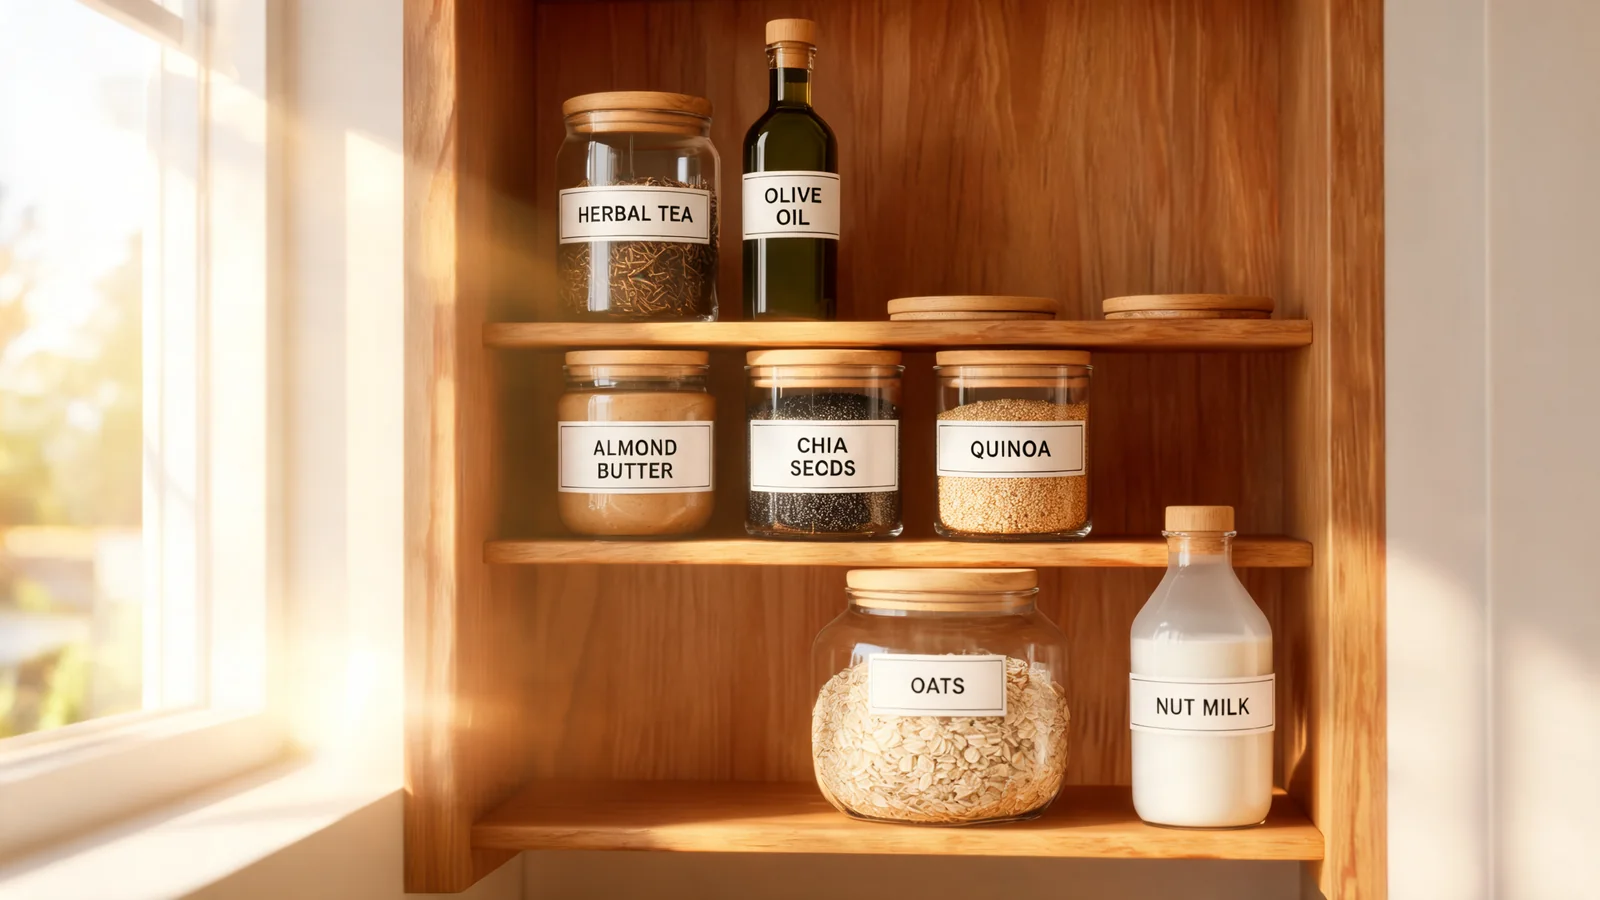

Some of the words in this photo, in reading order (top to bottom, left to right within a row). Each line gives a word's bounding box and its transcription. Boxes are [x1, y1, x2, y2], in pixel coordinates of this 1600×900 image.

[764, 186, 823, 204] OLIVE
[578, 205, 652, 224] HERBAL
[657, 205, 694, 224] TEA
[776, 208, 811, 226] OIL
[593, 438, 678, 457] ALMOND
[797, 436, 848, 454] CHIA
[970, 439, 1052, 460] QUINOA
[597, 462, 673, 480] BUTTER
[911, 677, 965, 695] OATS
[1156, 697, 1195, 716] NUT
[1203, 697, 1250, 717] MILK
